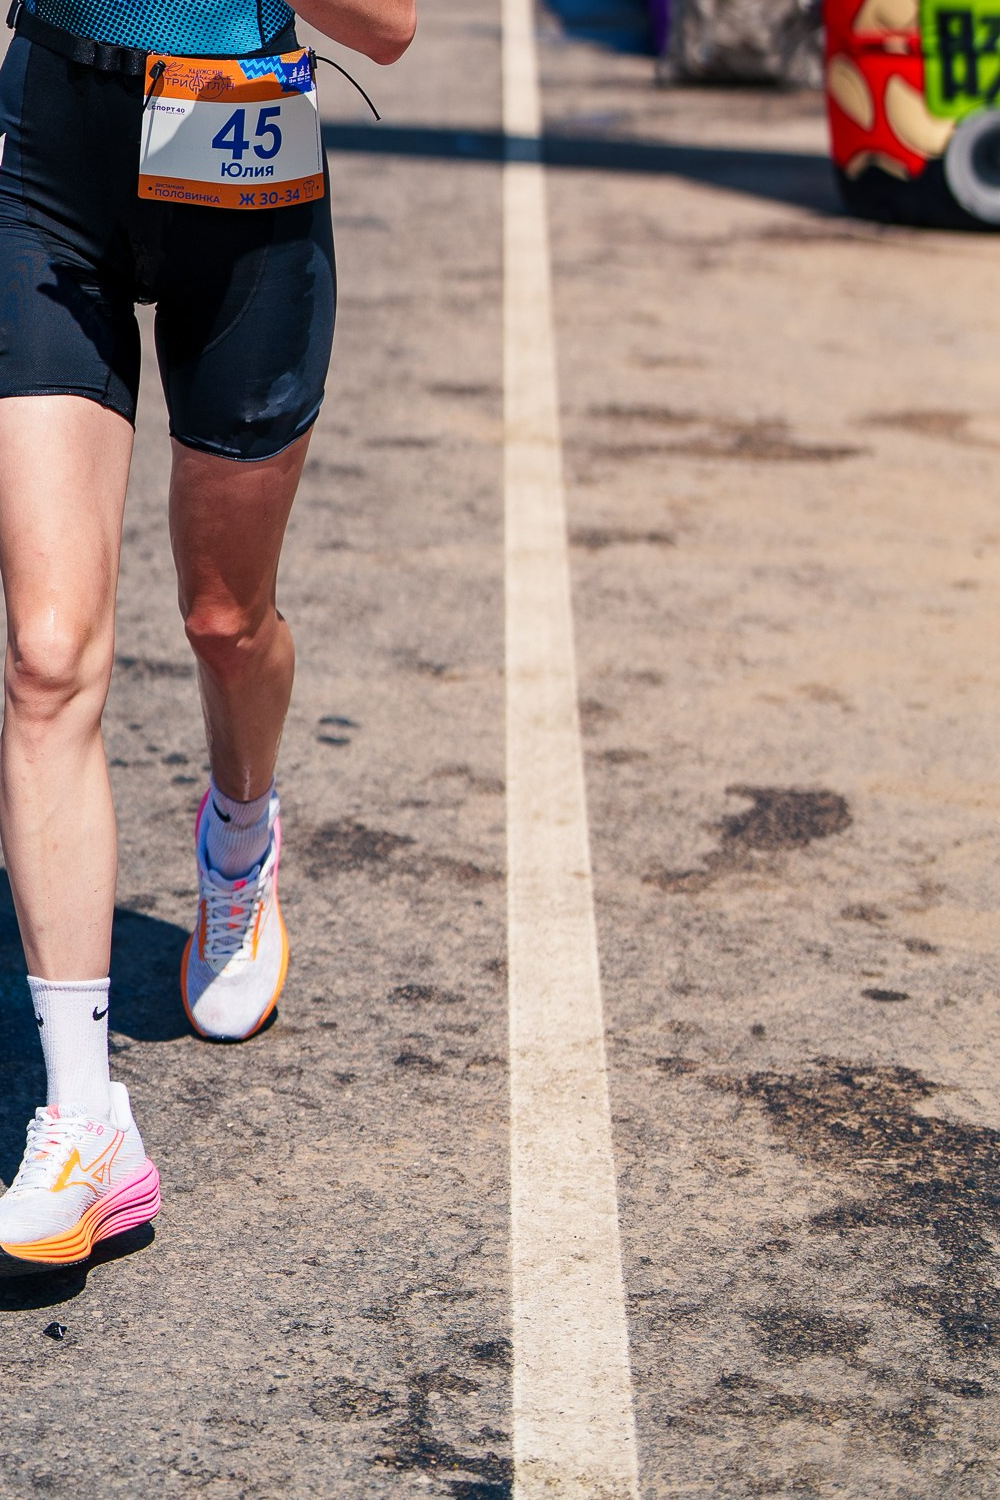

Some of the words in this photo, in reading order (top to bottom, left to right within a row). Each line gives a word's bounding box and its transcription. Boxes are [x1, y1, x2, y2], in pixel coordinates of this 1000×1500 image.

[151, 104, 175, 113] СПОРТ
[211, 106, 283, 160] 45
[221, 162, 274, 178] Юлия
[154, 188, 221, 204] ПОЛОВИНКА
[239, 192, 256, 206] Ж
[259, 188, 300, 206] 30-34
